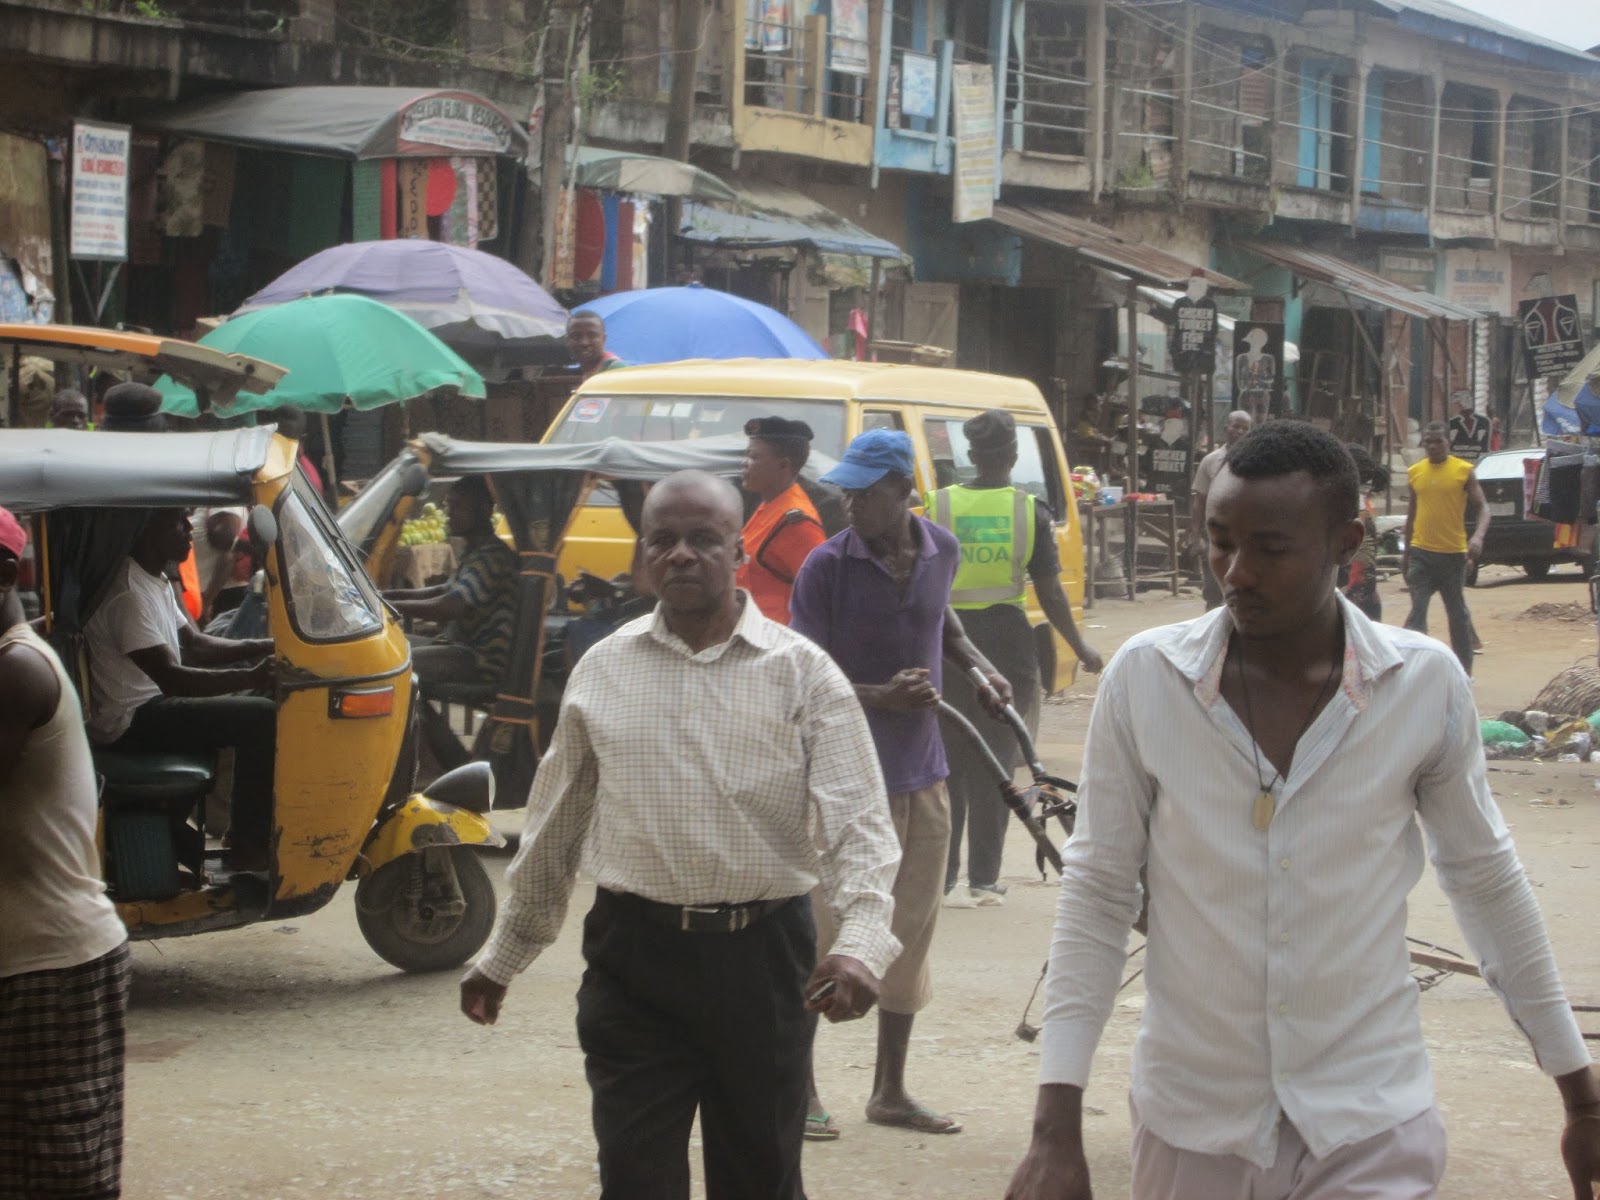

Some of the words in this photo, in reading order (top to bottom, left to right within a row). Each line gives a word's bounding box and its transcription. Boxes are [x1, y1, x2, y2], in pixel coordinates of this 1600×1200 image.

[1178, 307, 1214, 319] CHICKEN
[1178, 319, 1213, 331] TURKEY
[1182, 331, 1204, 343] FISH
[1153, 449, 1187, 461] CHICKEN
[1153, 461, 1186, 473] TURKEY
[960, 547, 1009, 563] NOA
